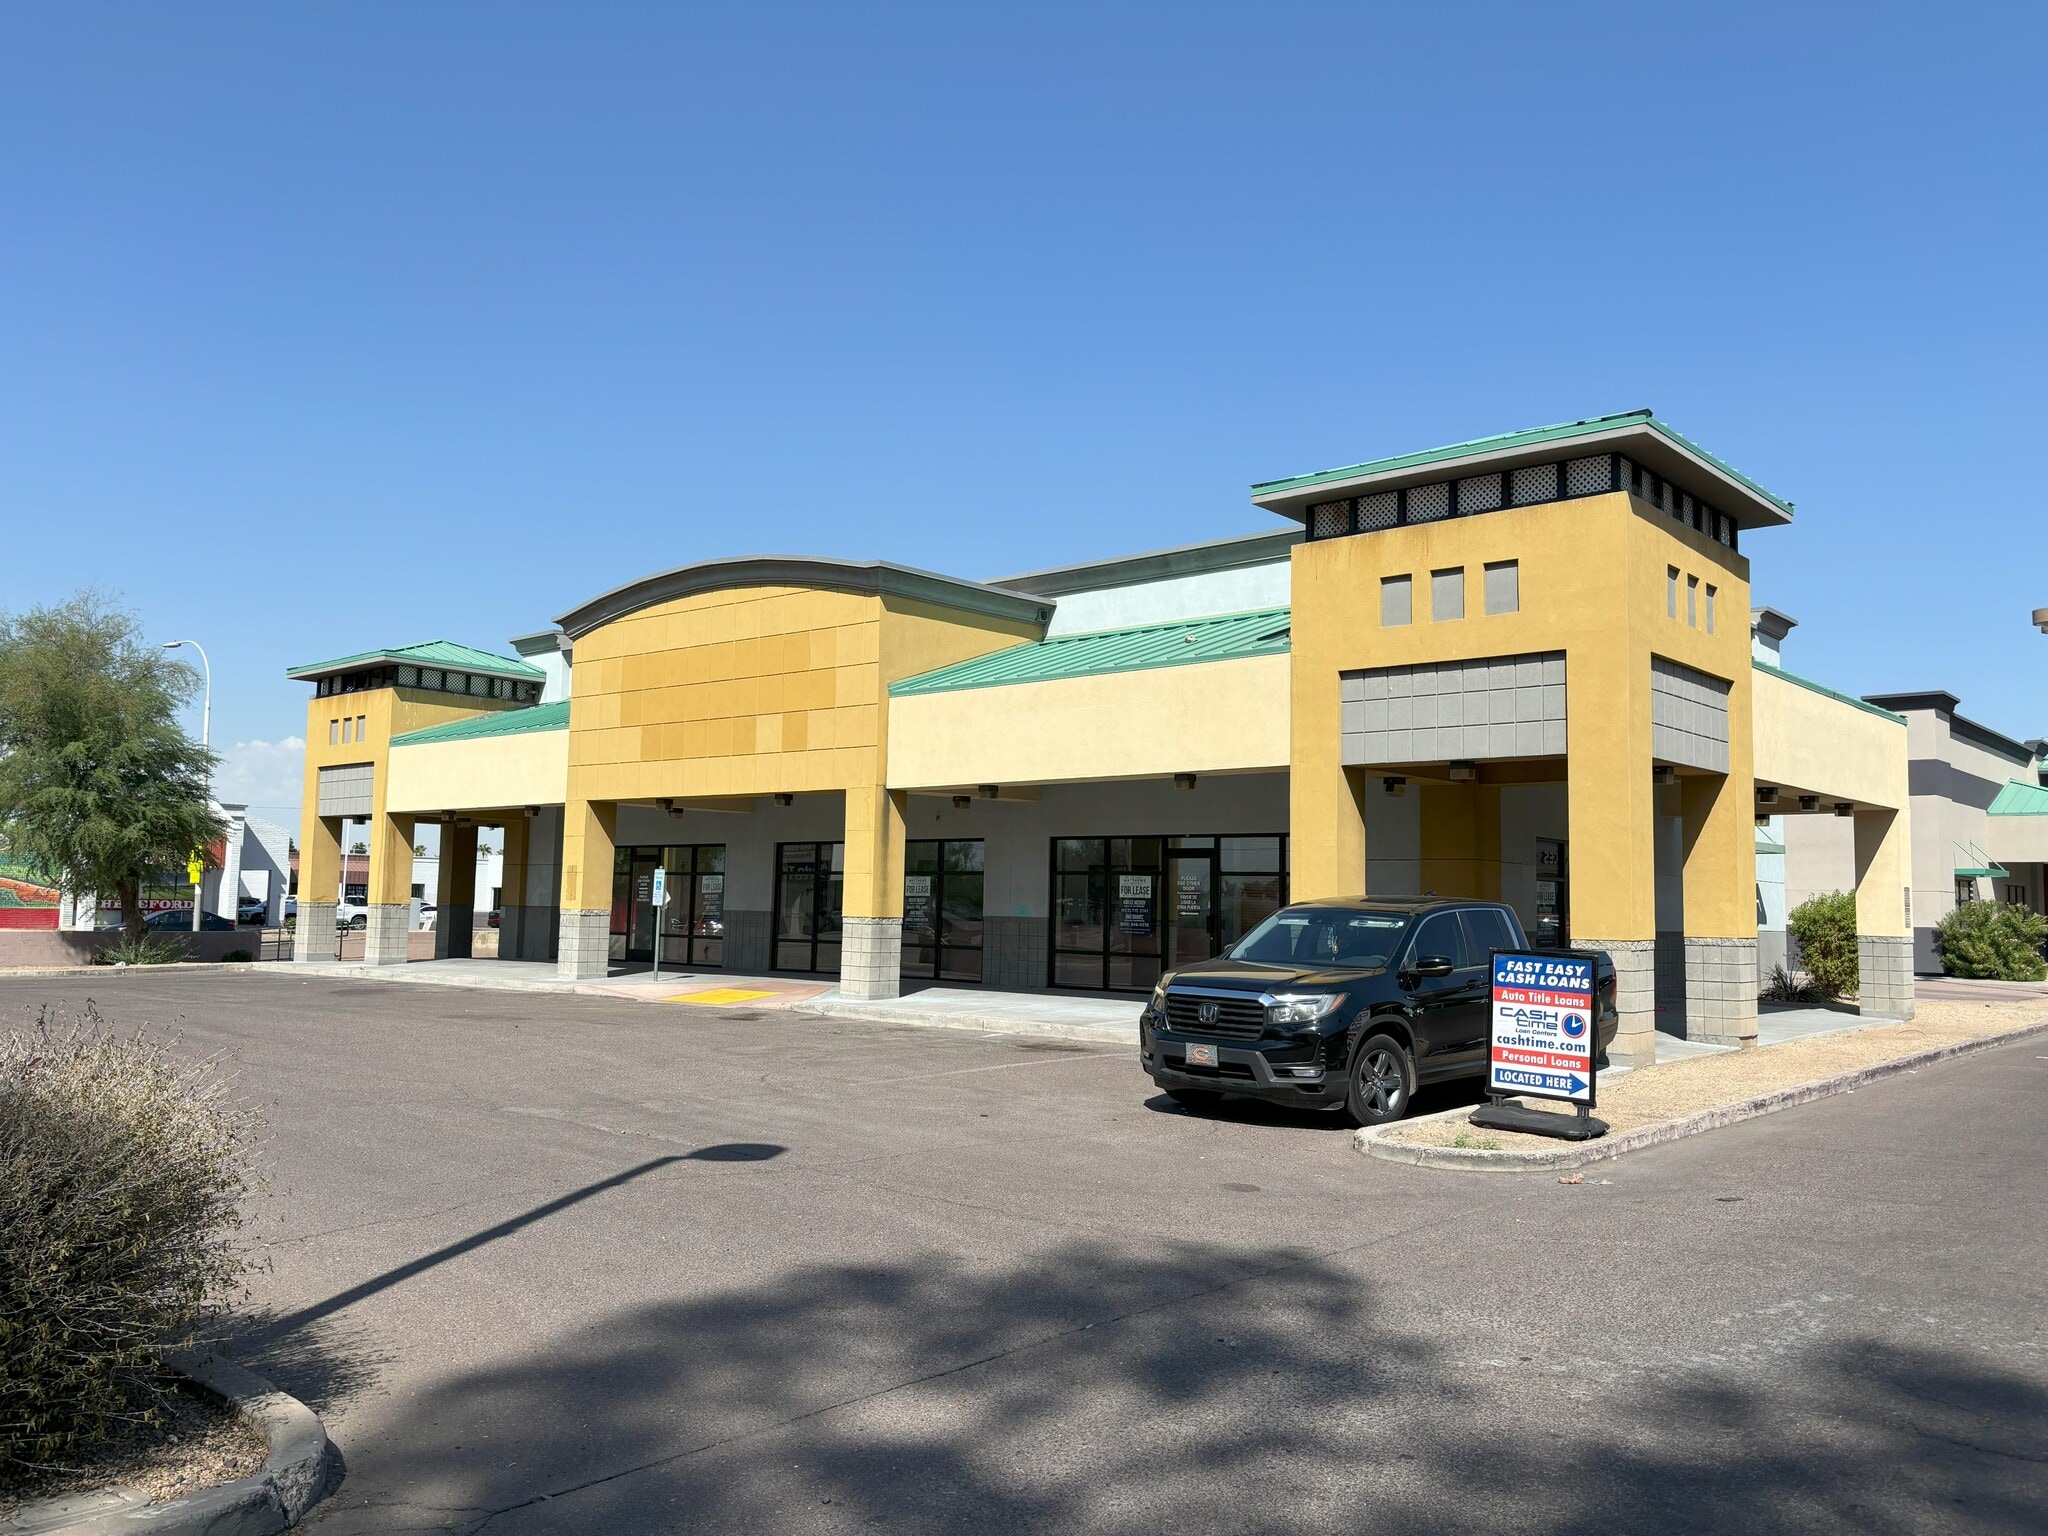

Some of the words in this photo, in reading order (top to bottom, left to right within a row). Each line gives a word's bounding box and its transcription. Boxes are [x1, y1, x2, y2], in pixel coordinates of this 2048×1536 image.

[906, 885, 915, 894] FOR
[916, 885, 930, 894] LEASE
[1121, 886, 1131, 894] FOR
[1132, 886, 1150, 895] LEASE
[101, 900, 195, 909] HEEFORD
[1507, 961, 1542, 973] FAST
[1545, 964, 1585, 976] EASY
[1497, 972, 1536, 985] CASH
[1539, 976, 1590, 989] LOANS
[1501, 990, 1525, 1001] Auto
[1528, 992, 1551, 1003] Title
[1555, 995, 1585, 1007] Loans
[1500, 1007, 1558, 1021] CASH
[1497, 1034, 1586, 1053] cashtime.com
[1502, 1051, 1547, 1065] Personal
[1551, 1056, 1581, 1068] Loans
[1500, 1071, 1543, 1085] LOCATED
[1546, 1077, 1573, 1089] HERE
